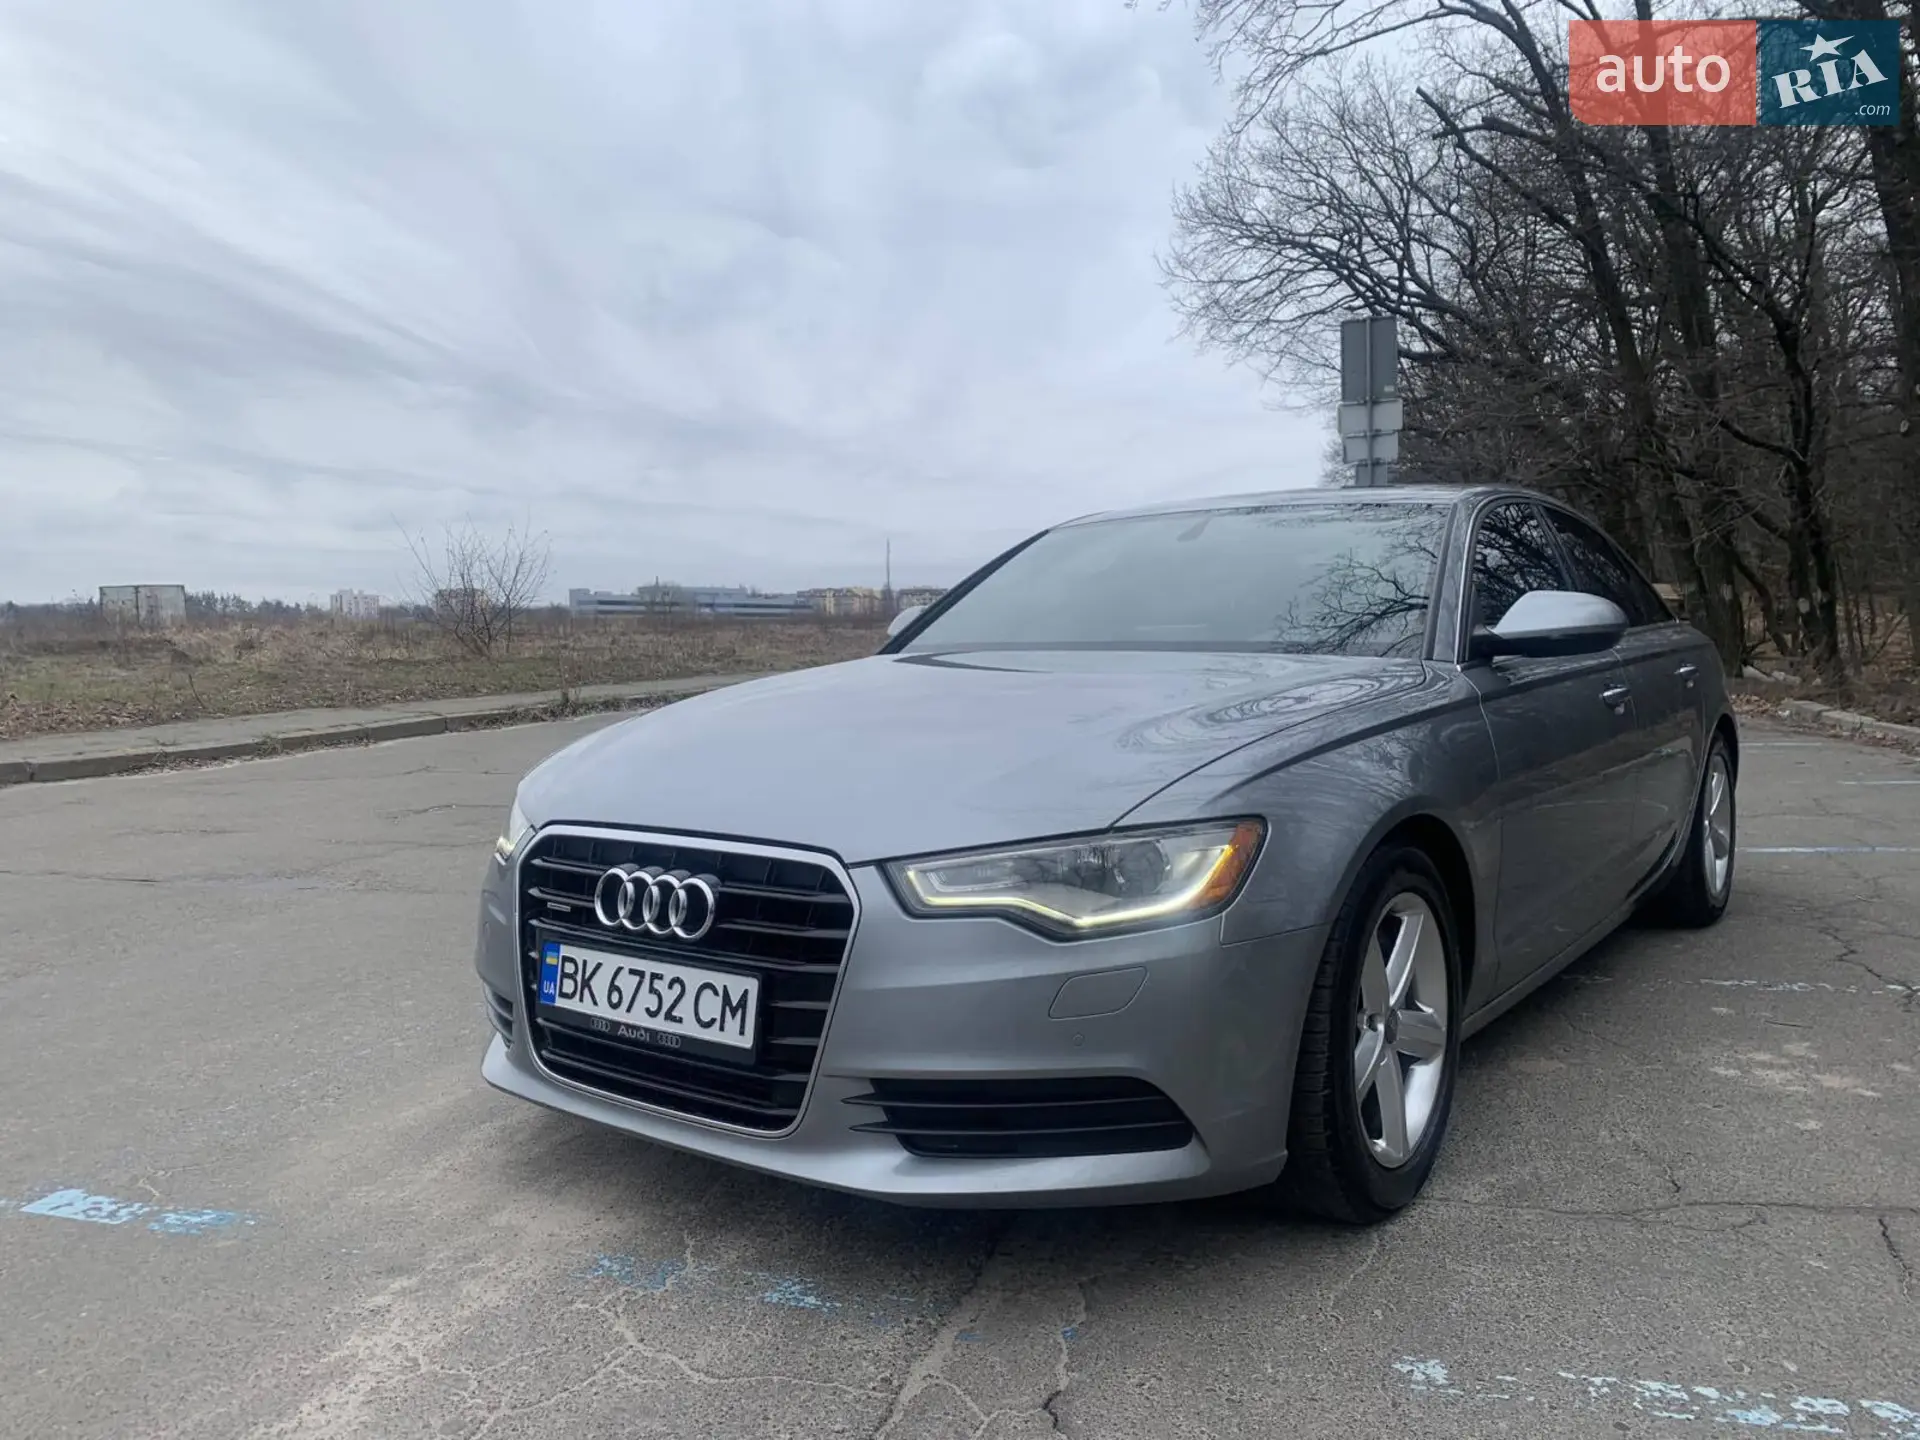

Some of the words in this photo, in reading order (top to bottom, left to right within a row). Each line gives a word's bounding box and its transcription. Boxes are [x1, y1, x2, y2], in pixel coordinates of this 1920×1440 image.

[543, 980, 555, 995] UA
[558, 955, 603, 1006] BK
[607, 966, 687, 1024] 6752
[693, 982, 749, 1036] CM
[617, 1025, 650, 1042] Audi
